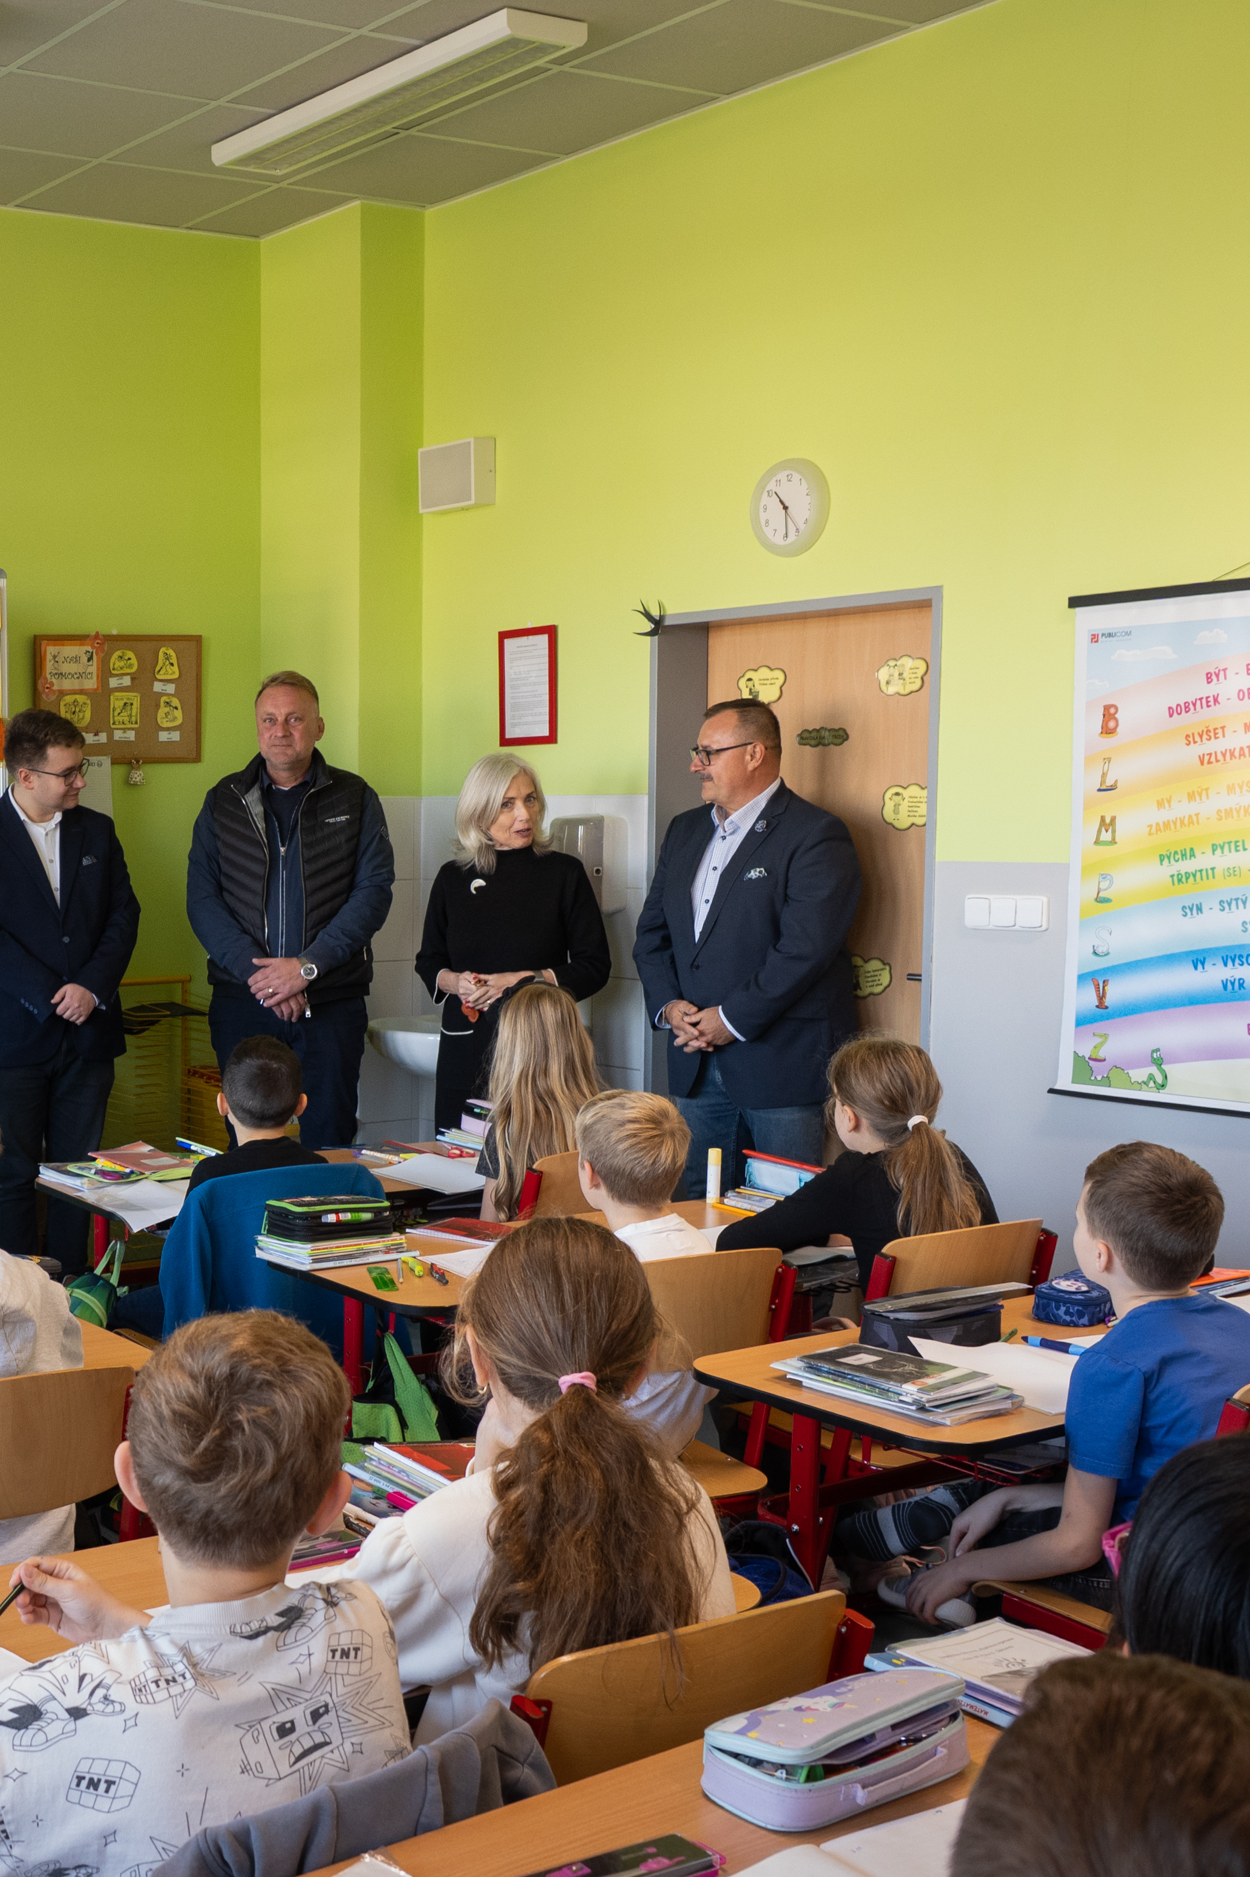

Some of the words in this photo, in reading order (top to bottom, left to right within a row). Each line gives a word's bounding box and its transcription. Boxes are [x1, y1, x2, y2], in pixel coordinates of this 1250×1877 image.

[786, 474, 793, 482] 12
[767, 489, 773, 498] 10
[763, 504, 767, 512] 9
[765, 519, 769, 527] 8
[62, 654, 81, 665] NAŠI
[1205, 666, 1228, 684] BÝT
[1168, 693, 1221, 718] DOBYTEK
[1099, 704, 1119, 738] B
[1185, 725, 1226, 746] SLYŠET
[1097, 757, 1118, 792] L
[1156, 795, 1172, 811] MY
[1187, 786, 1210, 803] MÝT
[1226, 780, 1250, 796] MYS
[1147, 812, 1200, 836] ZAMYKAT
[1216, 802, 1250, 821] SMÝK
[1094, 815, 1117, 846] M
[1159, 849, 1196, 866] PÝCHA
[1211, 839, 1248, 856] PYTEL
[1170, 867, 1216, 886] TŘPYTIT
[1223, 866, 1241, 880] (SE)
[1181, 902, 1203, 917] SYN
[1219, 894, 1248, 912] SYTÝ
[1092, 926, 1112, 956] S
[1192, 956, 1206, 971] VY
[1221, 953, 1250, 968] VYSO
[1221, 976, 1245, 991] VÝR
[1091, 978, 1109, 1010] V
[1088, 1032, 1109, 1062] Z
[330, 1647, 360, 1659] TNT
[151, 1671, 187, 1688] TNT
[75, 1775, 116, 1794] TNT
